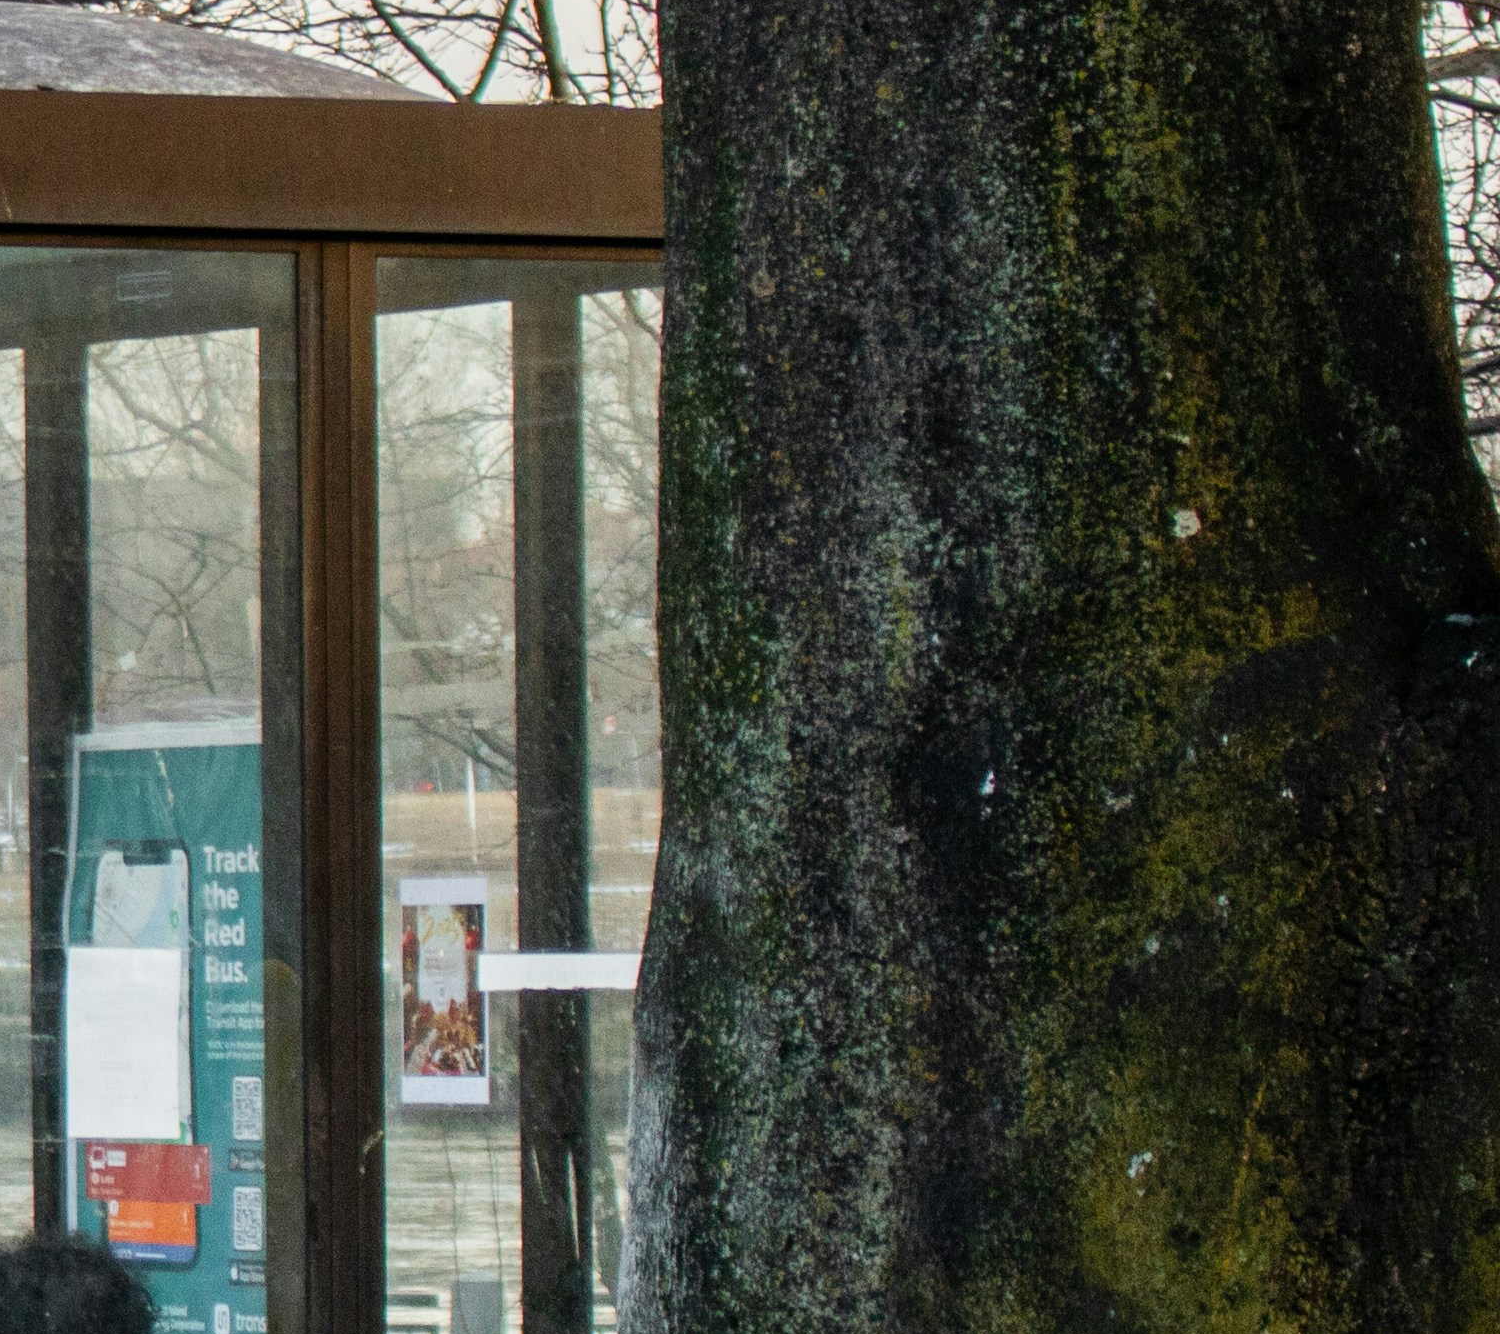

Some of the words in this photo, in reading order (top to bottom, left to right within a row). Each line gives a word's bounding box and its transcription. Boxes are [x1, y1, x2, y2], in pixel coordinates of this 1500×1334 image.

[203, 843, 260, 874] Track
[203, 881, 240, 911] the
[204, 917, 247, 947] Red
[205, 955, 249, 984] Bus.
